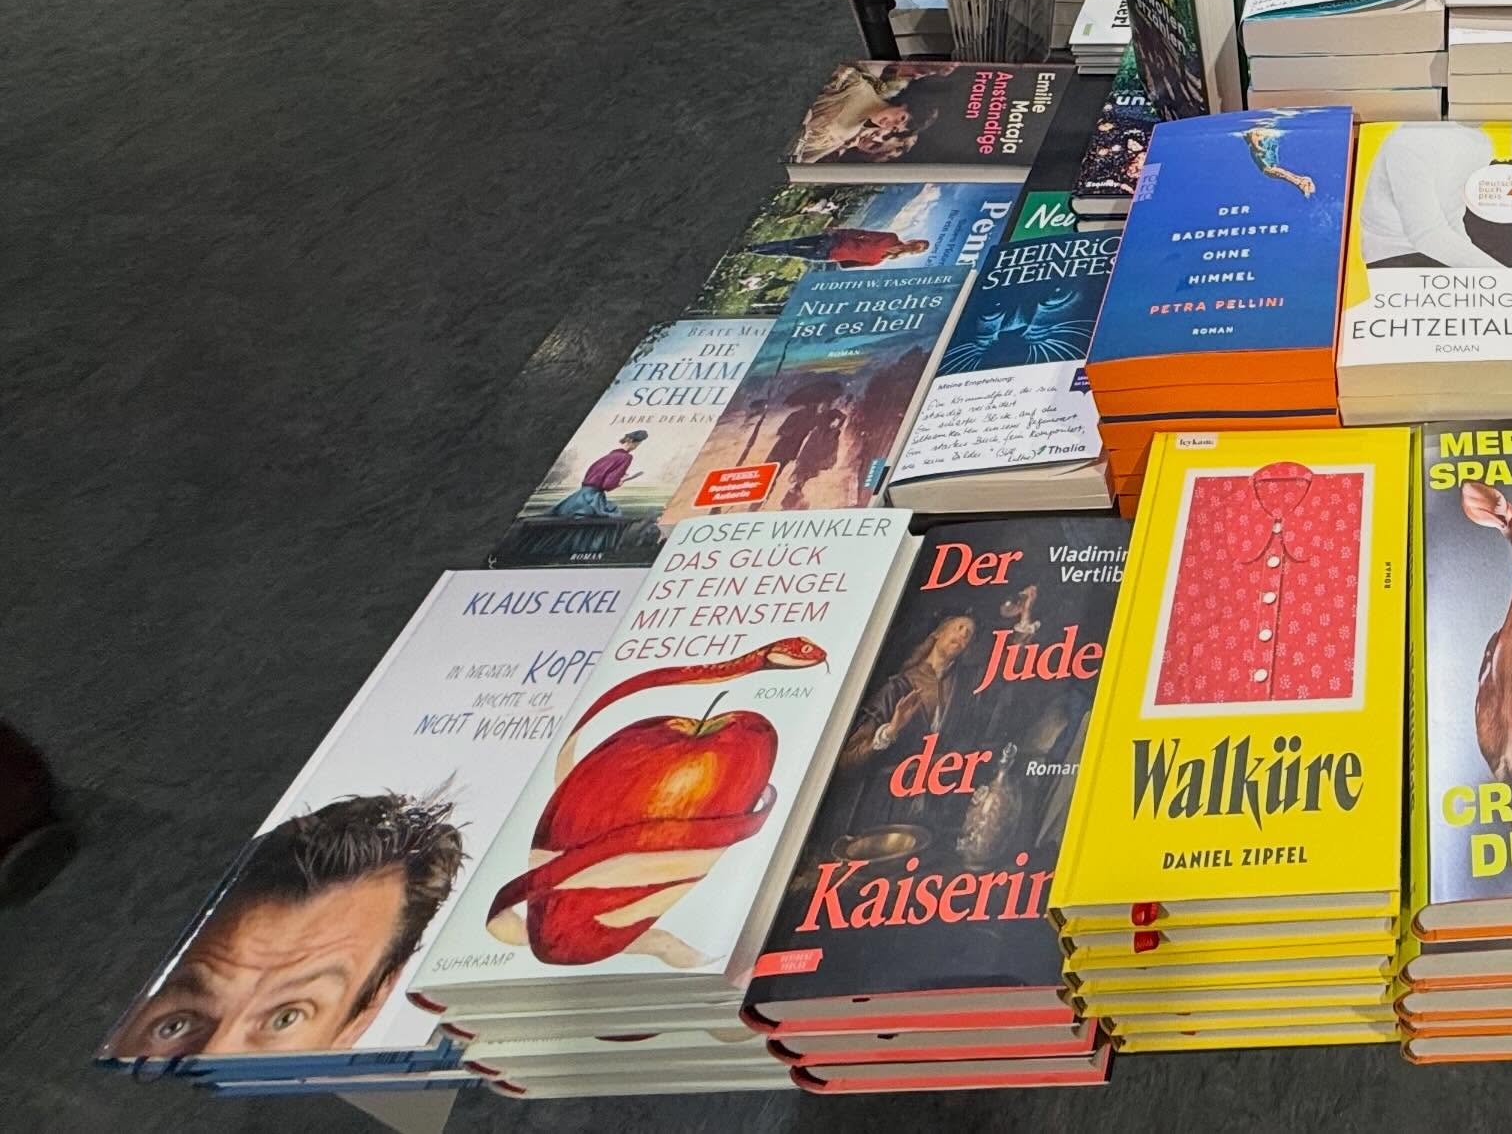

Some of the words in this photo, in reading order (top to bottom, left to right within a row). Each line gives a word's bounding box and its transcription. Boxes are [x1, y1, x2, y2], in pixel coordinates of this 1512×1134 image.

[966, 71, 994, 120] Frauen
[1031, 72, 1055, 114] Emilie
[979, 72, 1015, 156] Anständige
[1001, 100, 1027, 156] Mataja
[1218, 205, 1251, 217] DER
[1171, 224, 1290, 242] BADEMEISTER
[1202, 248, 1251, 262] OHNE
[811, 280, 863, 293] JUDITH
[882, 275, 953, 289] TASCHLER
[1187, 271, 1256, 286] HIMMEL
[1418, 273, 1498, 290] TONIO
[797, 299, 852, 317] Nur
[861, 293, 943, 314] nachts
[1149, 300, 1207, 315] PETRA
[1215, 296, 1285, 312] PELLINI
[792, 321, 830, 339] ist
[835, 322, 862, 336] es
[871, 313, 923, 334] hell
[1191, 325, 1235, 336] ROMAN
[698, 341, 739, 359] DIE
[1435, 344, 1480, 355] ROMAN
[609, 413, 654, 426] JAHRE
[1047, 443, 1086, 455] Thalia
[676, 519, 766, 546] JOSEF
[770, 516, 893, 542] WINKLER
[569, 552, 604, 561] ROMAN
[663, 551, 719, 574] DAS
[728, 544, 830, 569] GLÜCK
[920, 541, 1024, 593] Der
[1060, 565, 1124, 584] Vertlib
[647, 578, 682, 602] IST
[696, 576, 745, 598] EIN
[753, 572, 849, 596] ENGEL
[463, 590, 549, 616] KLAUS
[549, 589, 623, 614] ECKEL
[630, 608, 682, 632] MIT
[689, 600, 831, 628] ERNSTEM
[614, 632, 749, 663] GESICHT
[972, 624, 1104, 696] Jude
[754, 686, 814, 700] ROMAN
[889, 733, 993, 799] der
[1131, 734, 1366, 832] Walküre
[1162, 849, 1234, 871] DANIEL
[1242, 845, 1309, 866] ZIPFEL
[431, 953, 516, 973] SUHRKAMP
